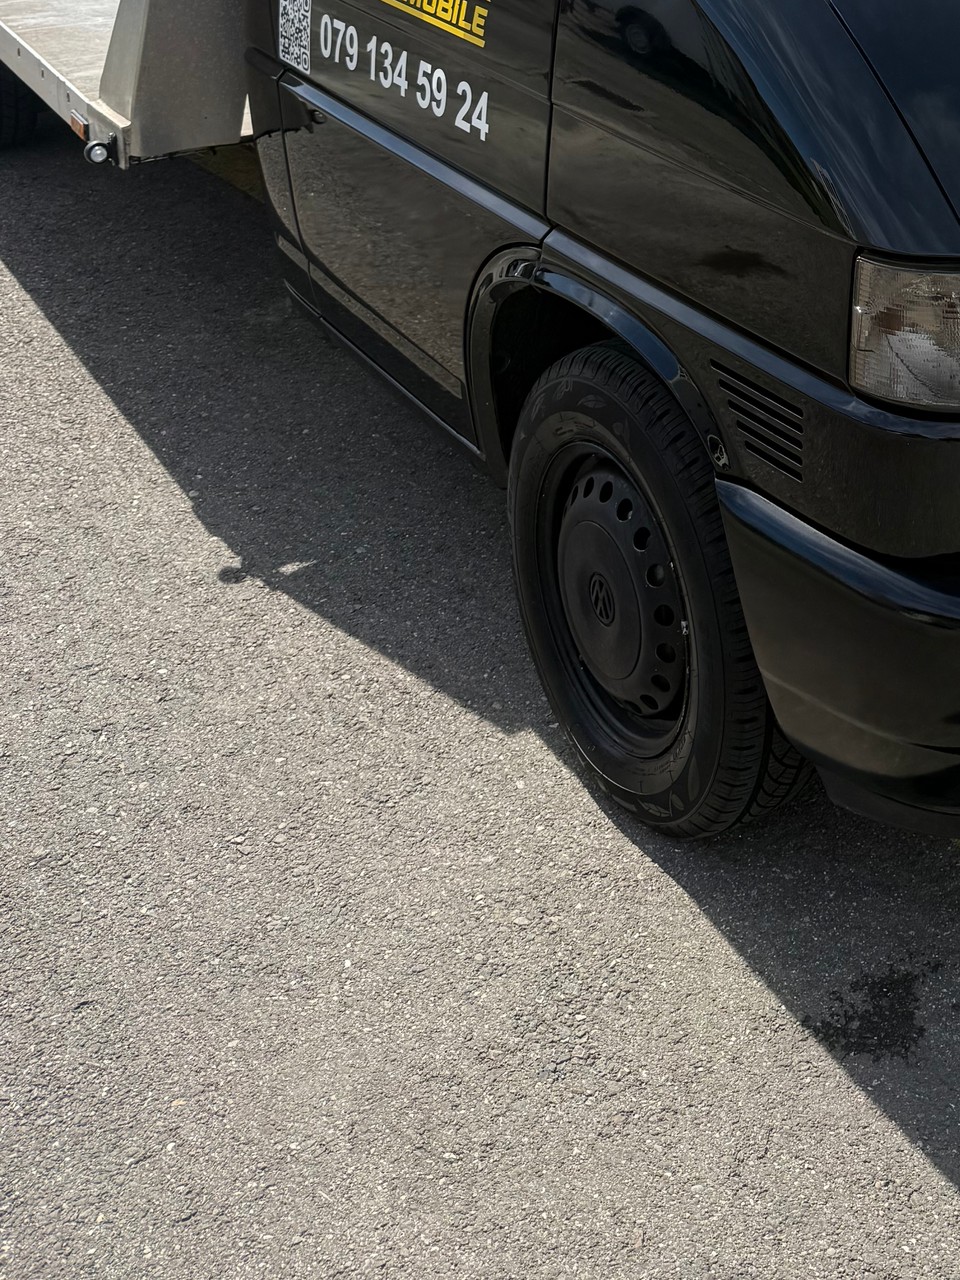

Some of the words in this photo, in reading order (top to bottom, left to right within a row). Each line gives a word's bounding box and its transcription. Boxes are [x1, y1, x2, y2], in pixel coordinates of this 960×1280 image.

[320, 14, 359, 71] 079
[366, 35, 408, 98] 134
[416, 60, 447, 118] 59
[454, 81, 490, 142] 24
